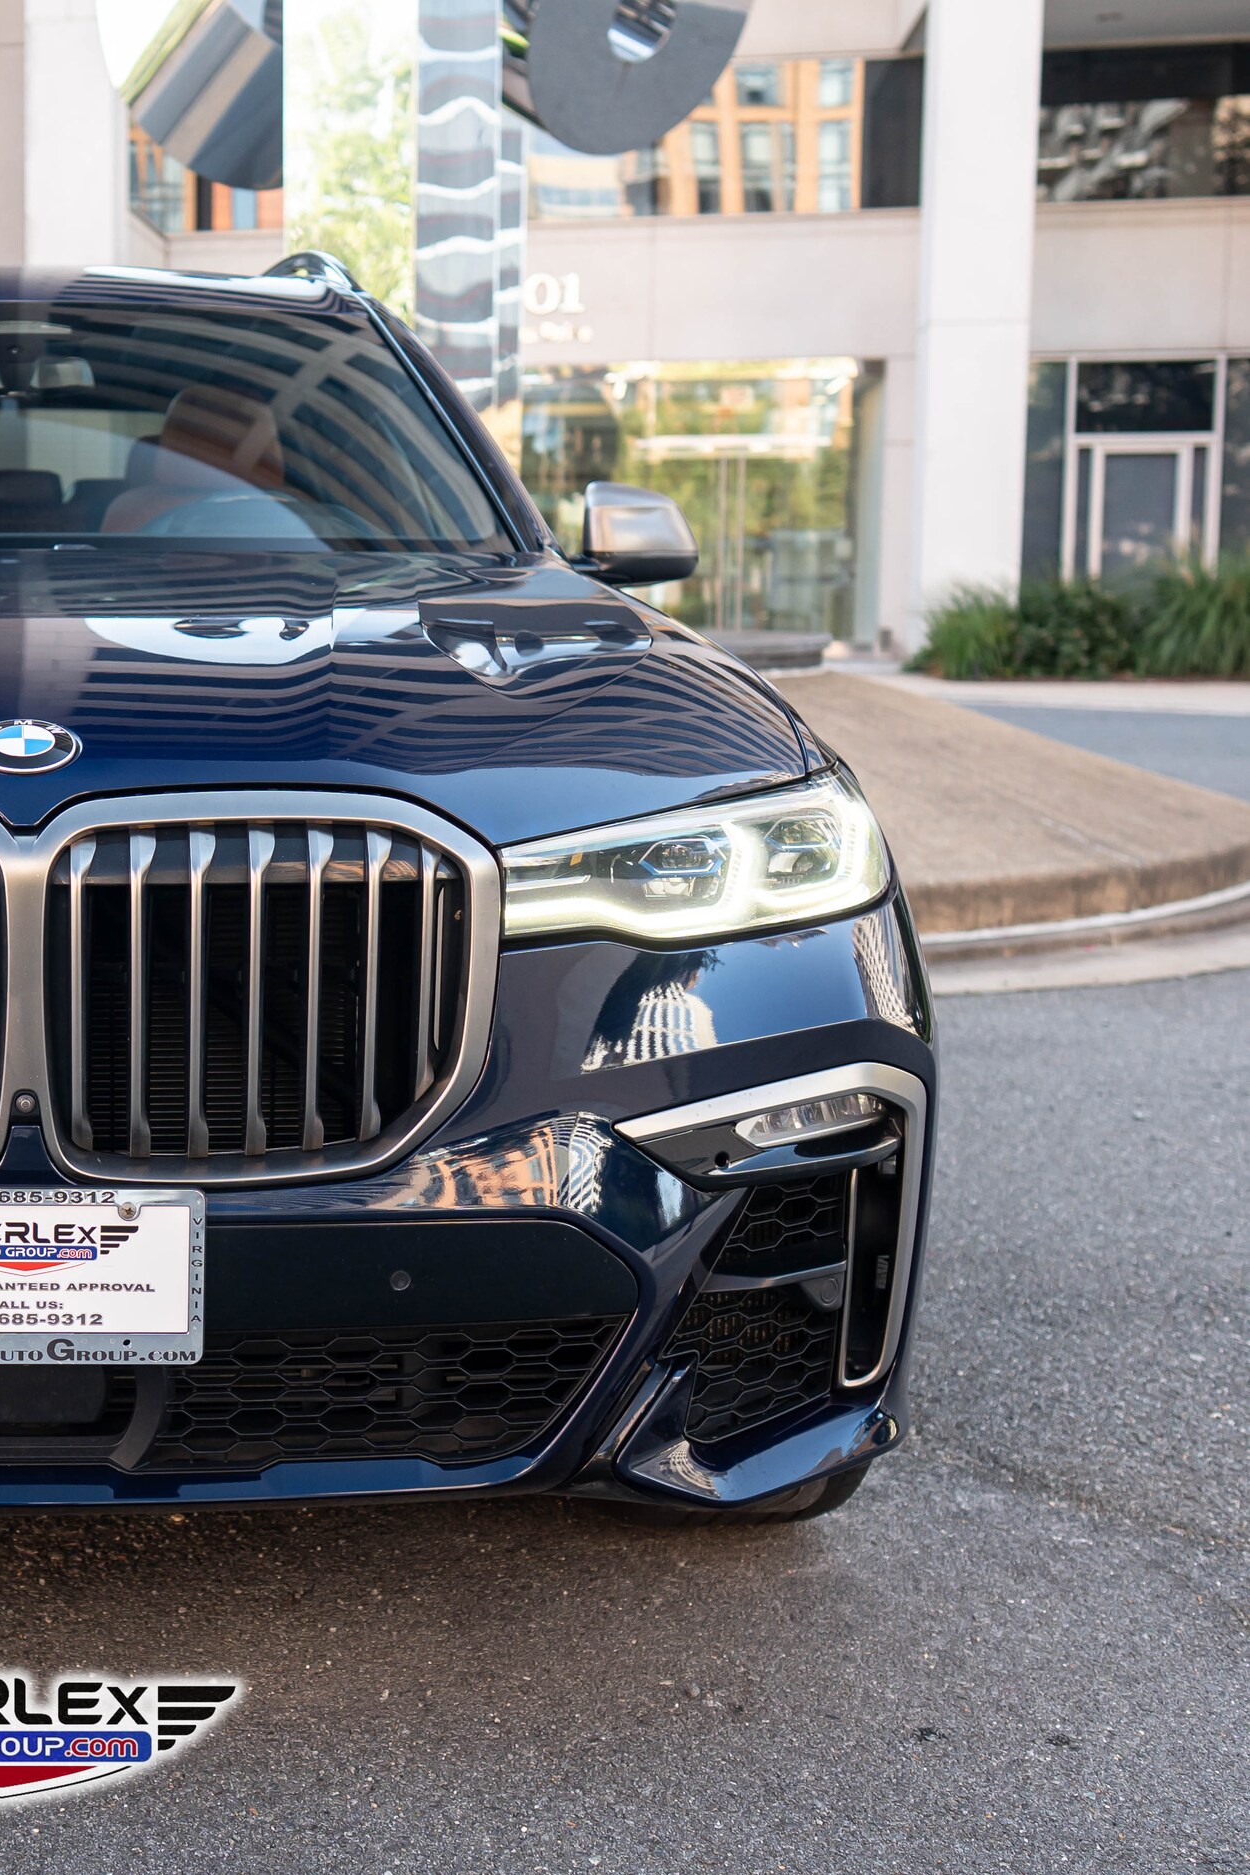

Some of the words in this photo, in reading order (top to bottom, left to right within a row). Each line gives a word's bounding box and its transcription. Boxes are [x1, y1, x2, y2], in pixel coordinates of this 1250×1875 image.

[5, 1247, 92, 1259] GROUP.com
[191, 1217, 203, 1323] VIRGINIA
[66, 1282, 156, 1292] APPROVAL
[35, 1300, 64, 1309] US:
